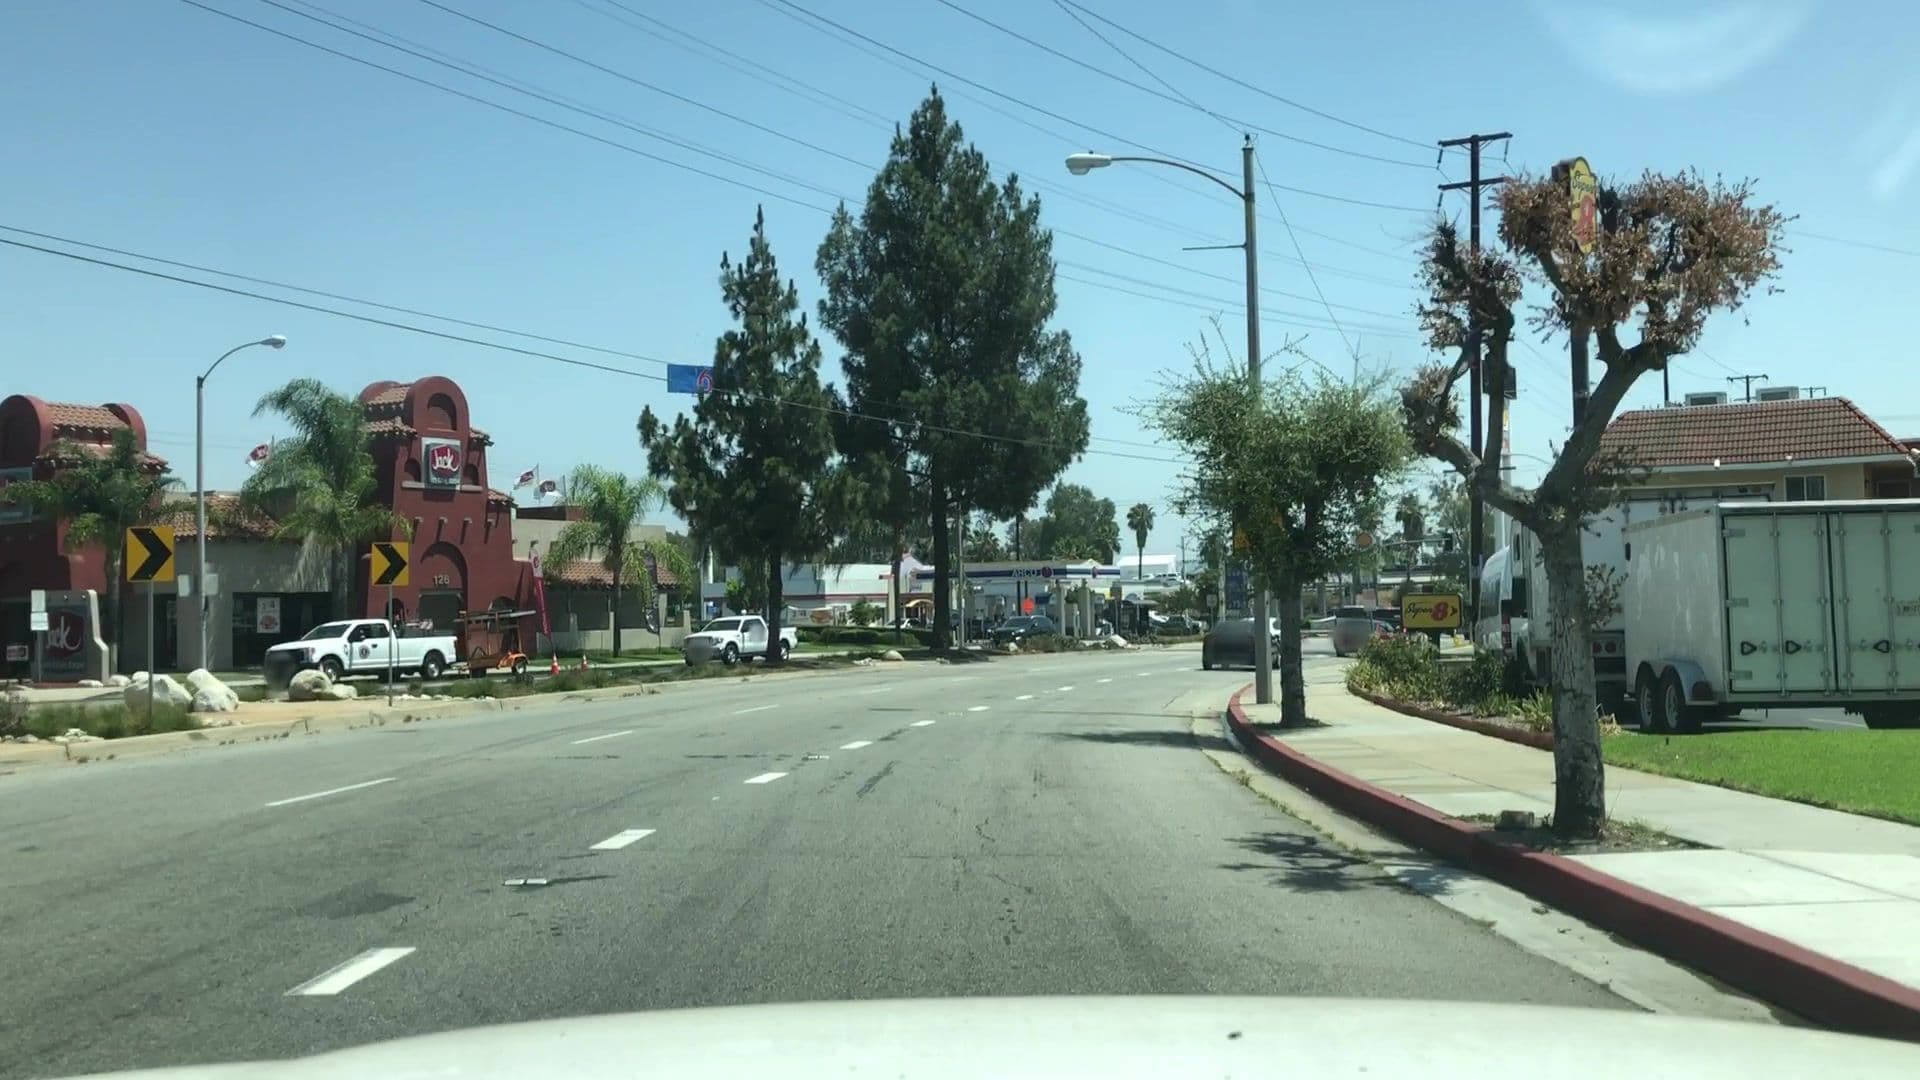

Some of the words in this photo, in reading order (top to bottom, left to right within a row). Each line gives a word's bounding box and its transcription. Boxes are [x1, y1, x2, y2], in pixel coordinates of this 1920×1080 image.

[1011, 568, 1037, 578] ARCO
[432, 575, 450, 585] 126
[1407, 602, 1433, 619] Super
[1431, 601, 1449, 621] 8
